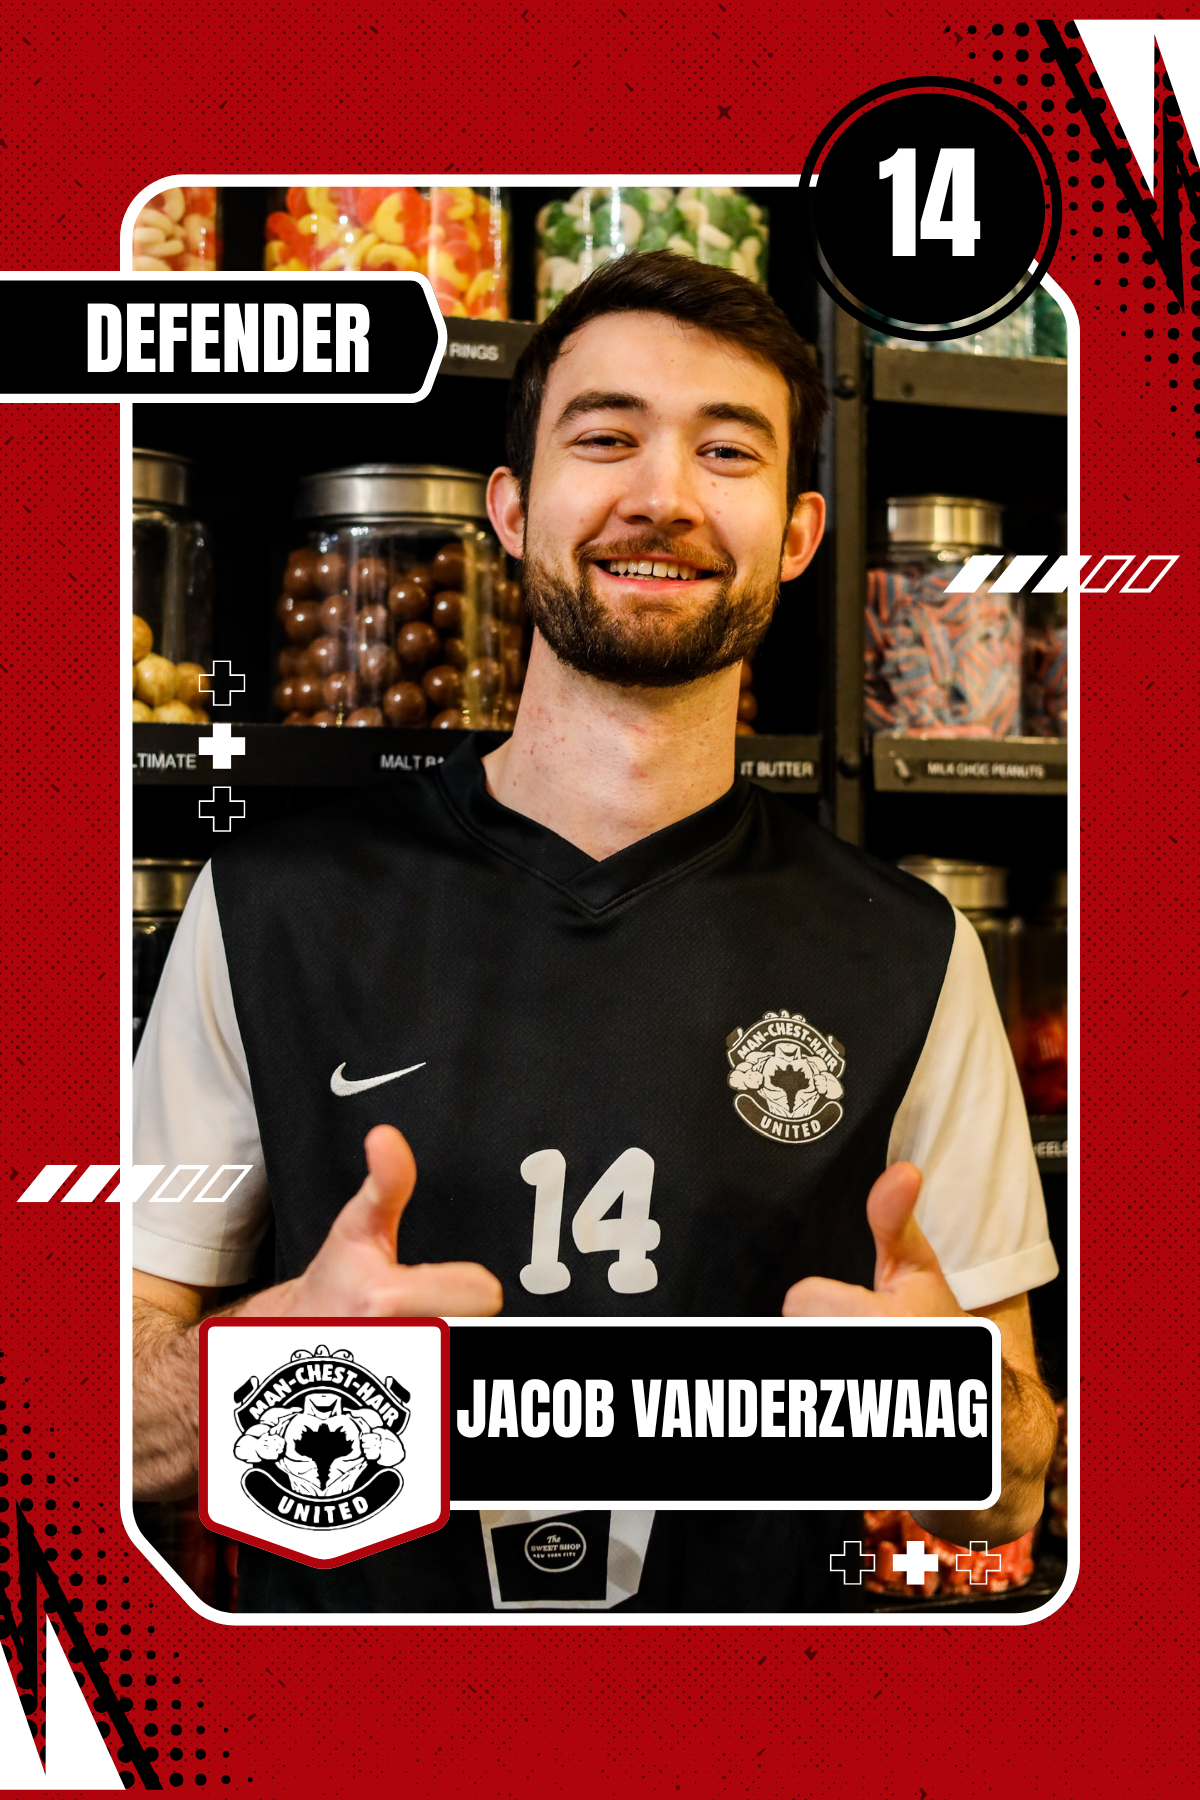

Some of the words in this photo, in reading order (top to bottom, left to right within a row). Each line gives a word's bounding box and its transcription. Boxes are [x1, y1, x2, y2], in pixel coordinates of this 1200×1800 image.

[448, 342, 500, 361] RINGS
[132, 752, 197, 769] TIMATE
[380, 754, 422, 770] MALT
[756, 761, 814, 778] BUTTER
[927, 761, 956, 776] MILK
[956, 761, 989, 779] CHOC
[991, 762, 1046, 780] PEANUTS
[737, 1022, 838, 1072] MAN-CHEST-HAIR
[760, 1115, 821, 1139] UNITED
[519, 1147, 661, 1295] 14
[530, 1544, 559, 1552] SWEET
[559, 1543, 581, 1551] SHOP
[546, 1534, 561, 1544] The
